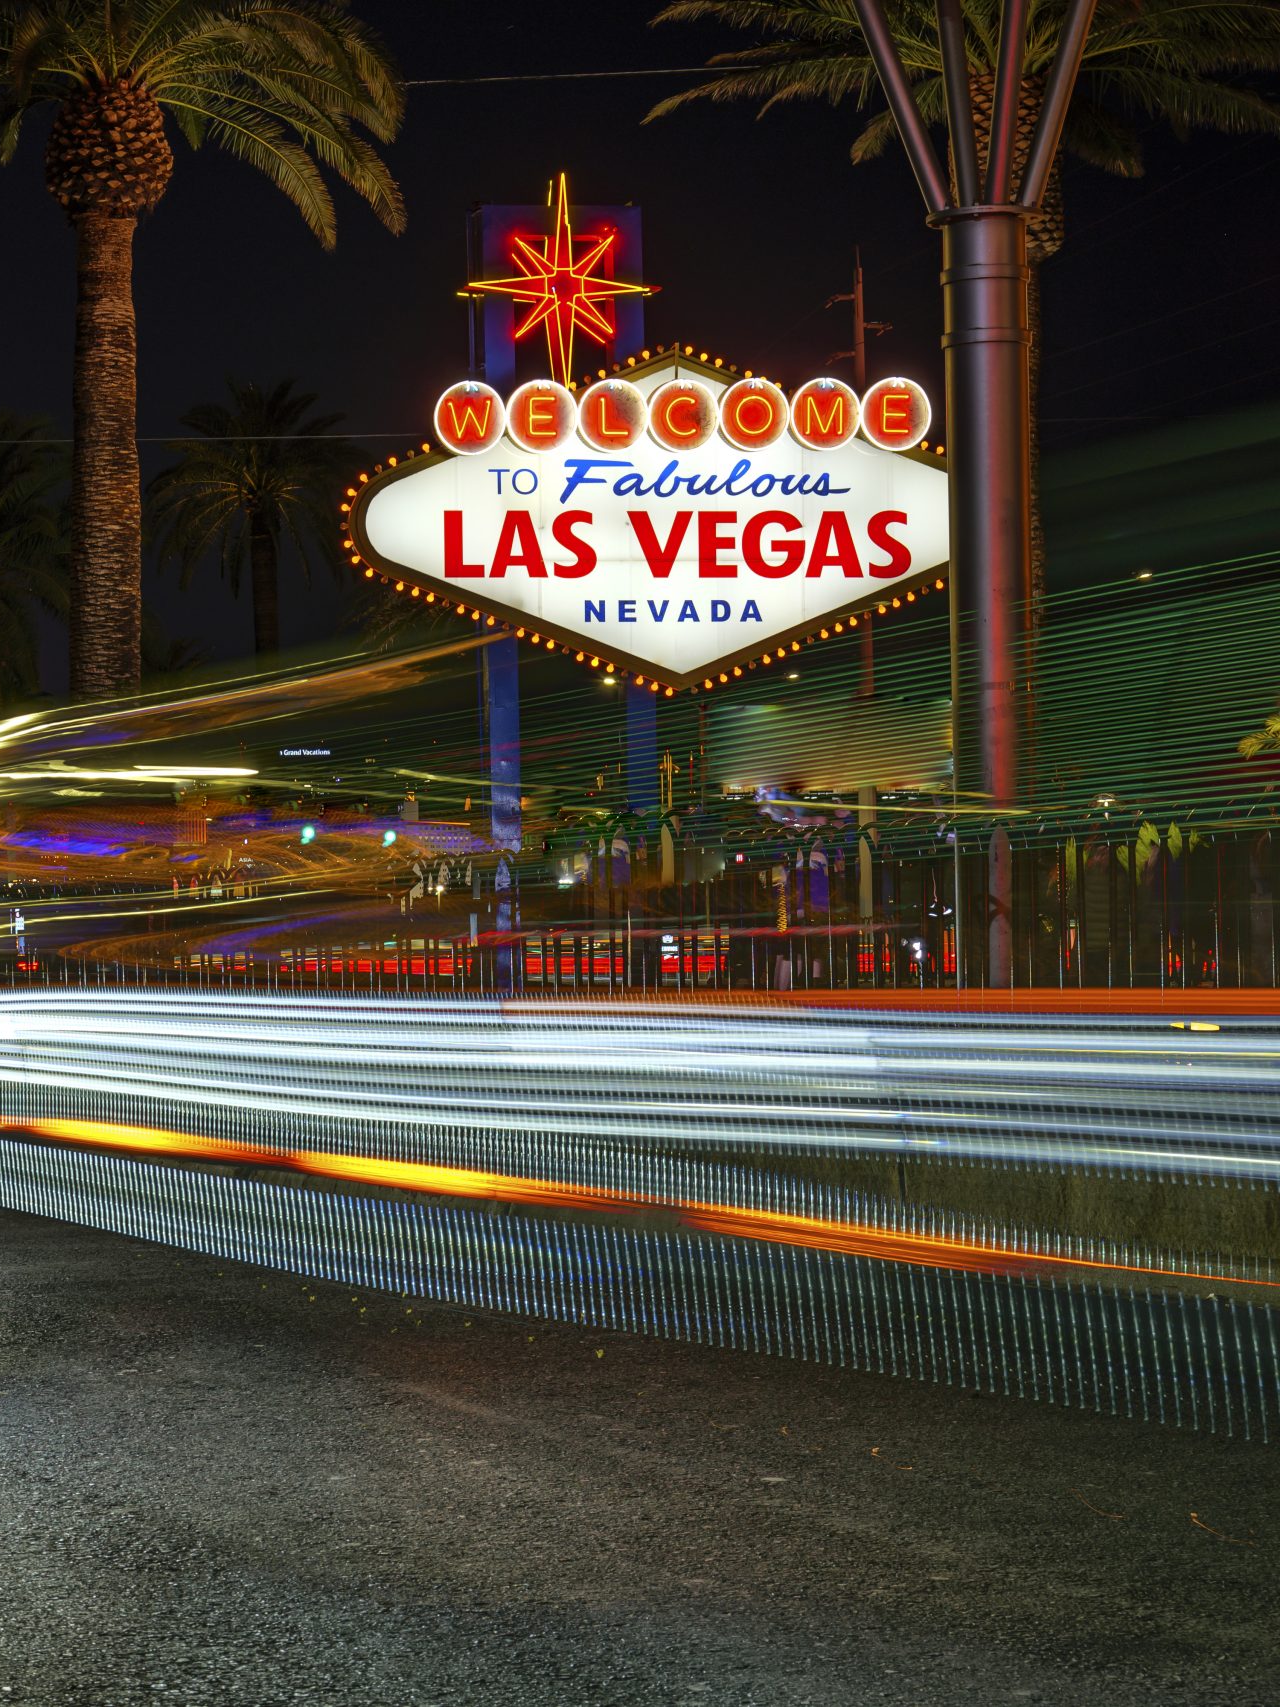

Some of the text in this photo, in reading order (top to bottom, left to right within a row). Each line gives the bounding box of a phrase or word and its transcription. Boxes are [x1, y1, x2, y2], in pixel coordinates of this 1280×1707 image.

[445, 391, 913, 441] WELCOME
[488, 459, 851, 504] TO Fabulous
[443, 510, 912, 579] LAS VEGAS
[584, 599, 763, 623] NEVADA
